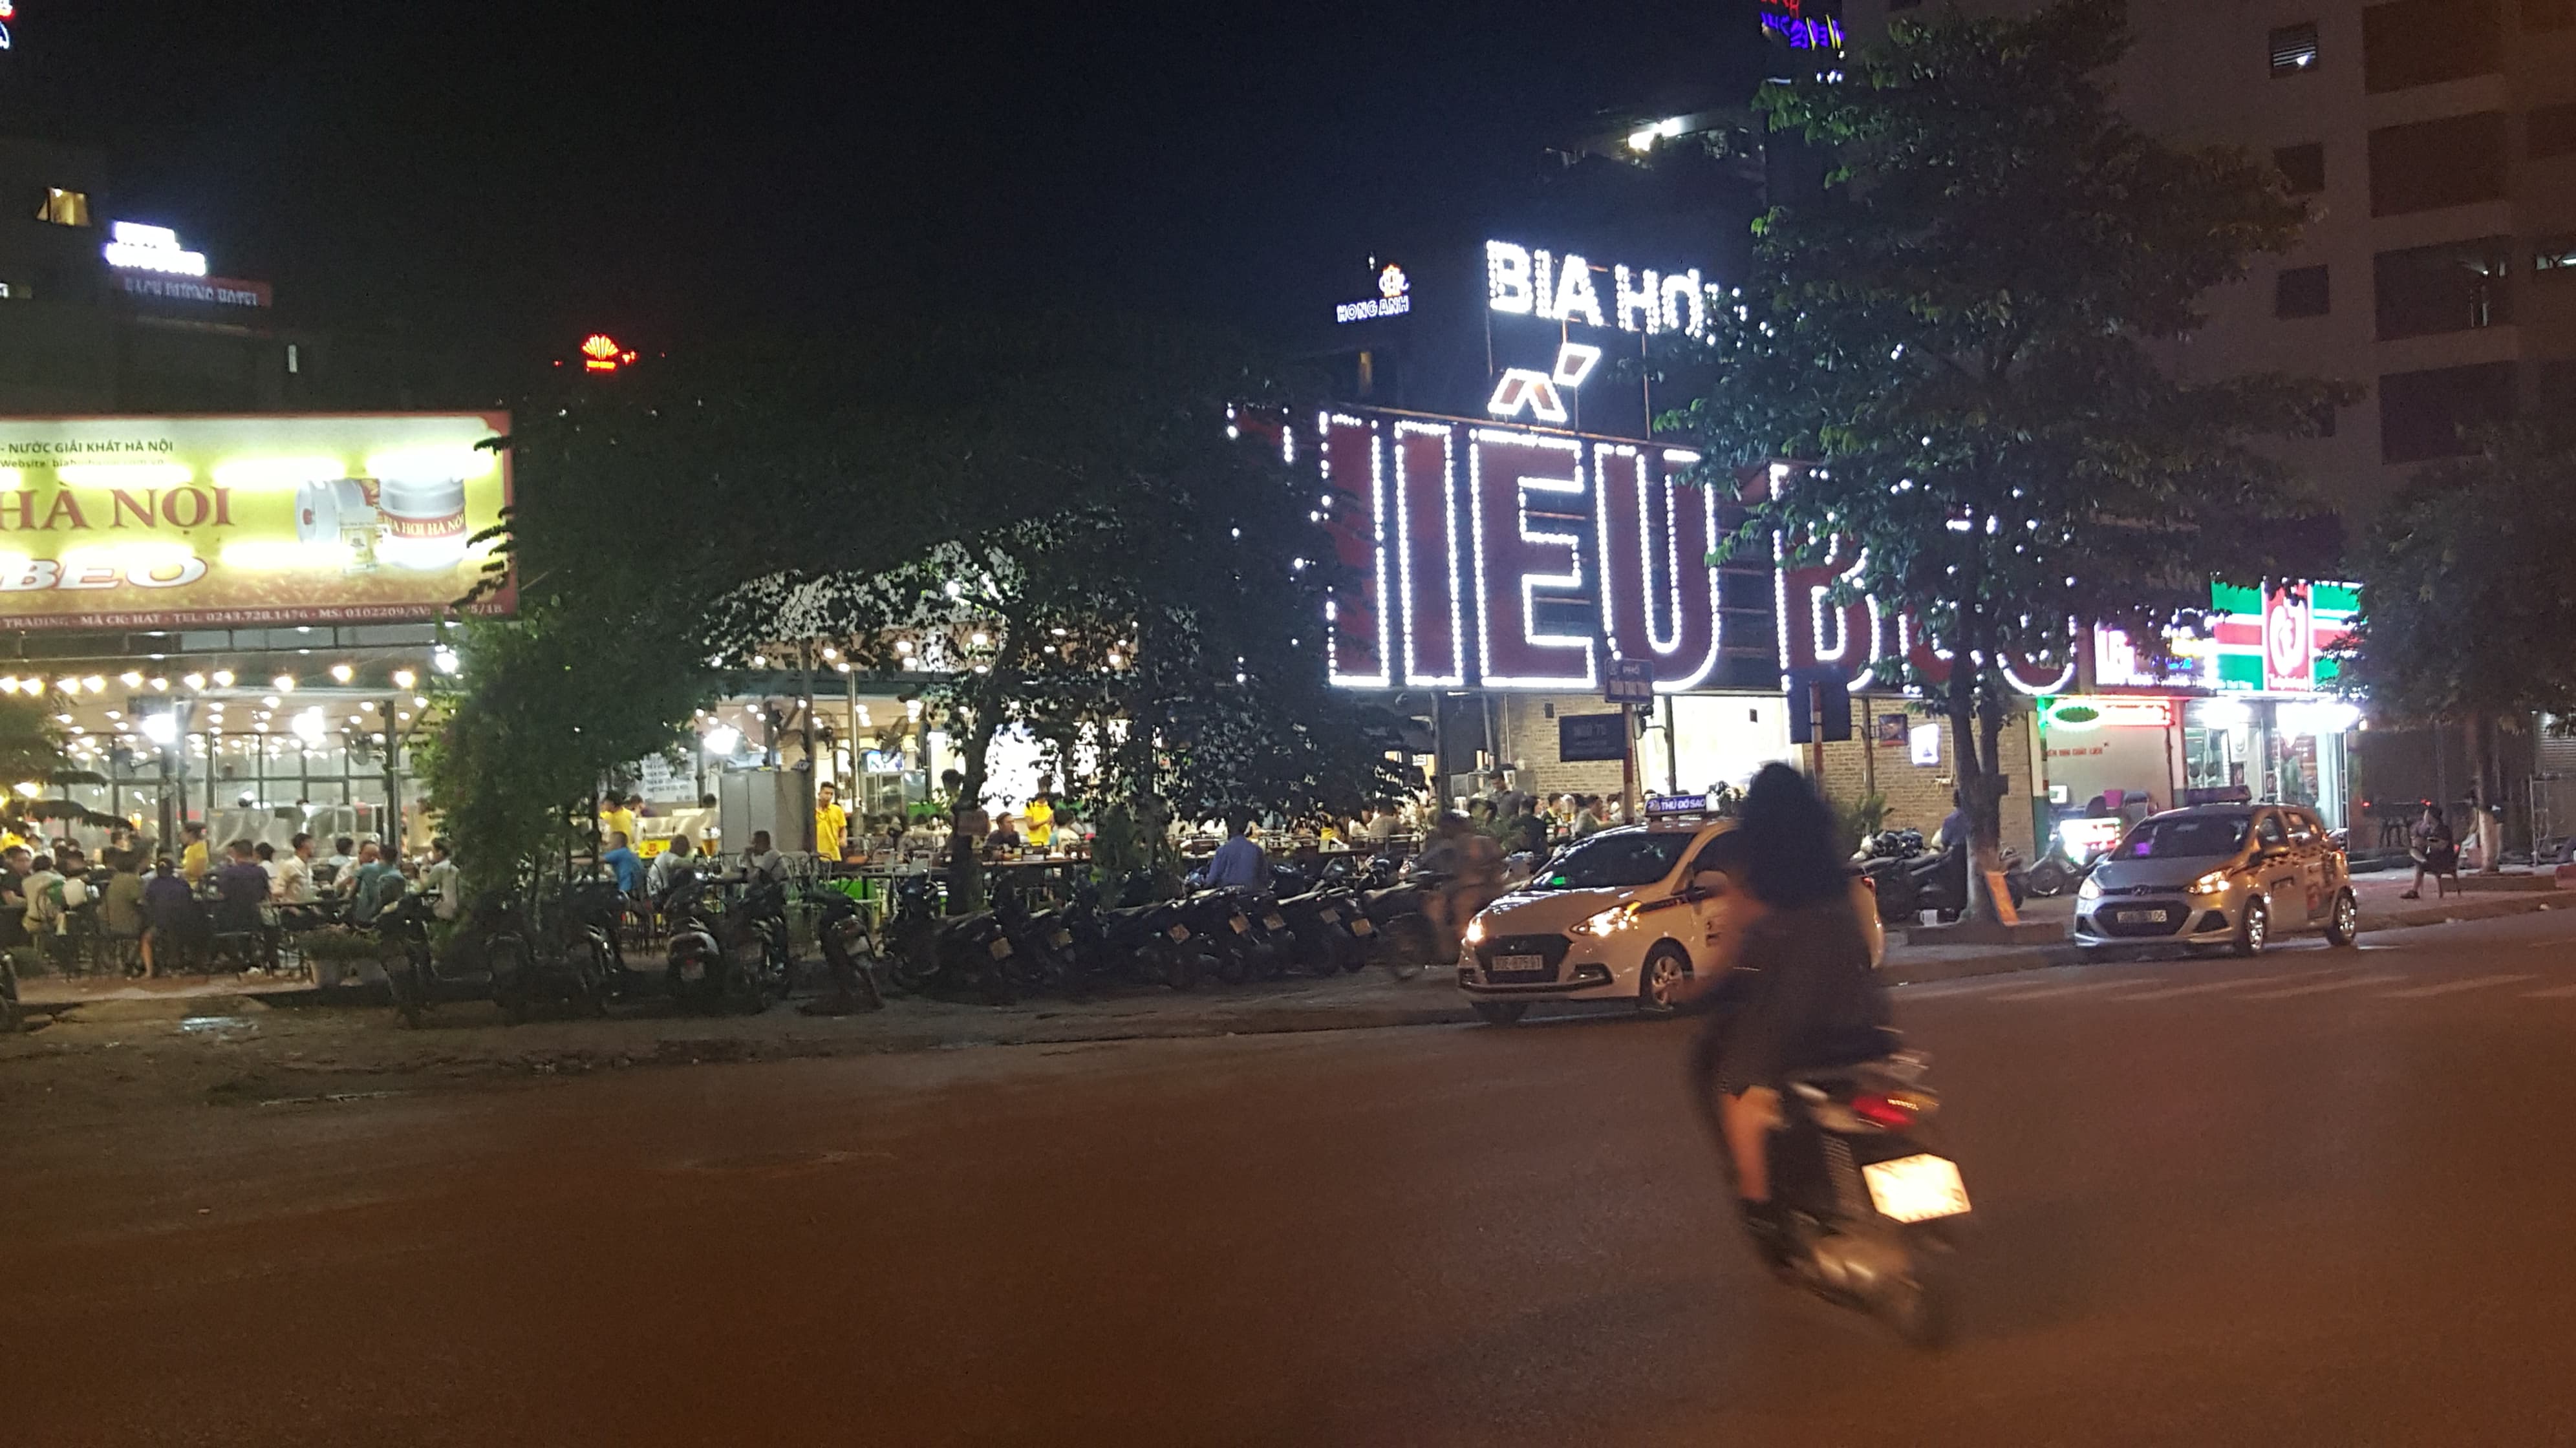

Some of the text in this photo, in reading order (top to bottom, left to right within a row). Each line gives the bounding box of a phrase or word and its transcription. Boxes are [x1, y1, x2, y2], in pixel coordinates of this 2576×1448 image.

[1378, 295, 1410, 315] ANH
[1487, 240, 1723, 344] BIA HƠ
[125, 439, 144, 452] HÀ
[148, 438, 173, 454] NỘI
[0, 480, 92, 531] HÀ
